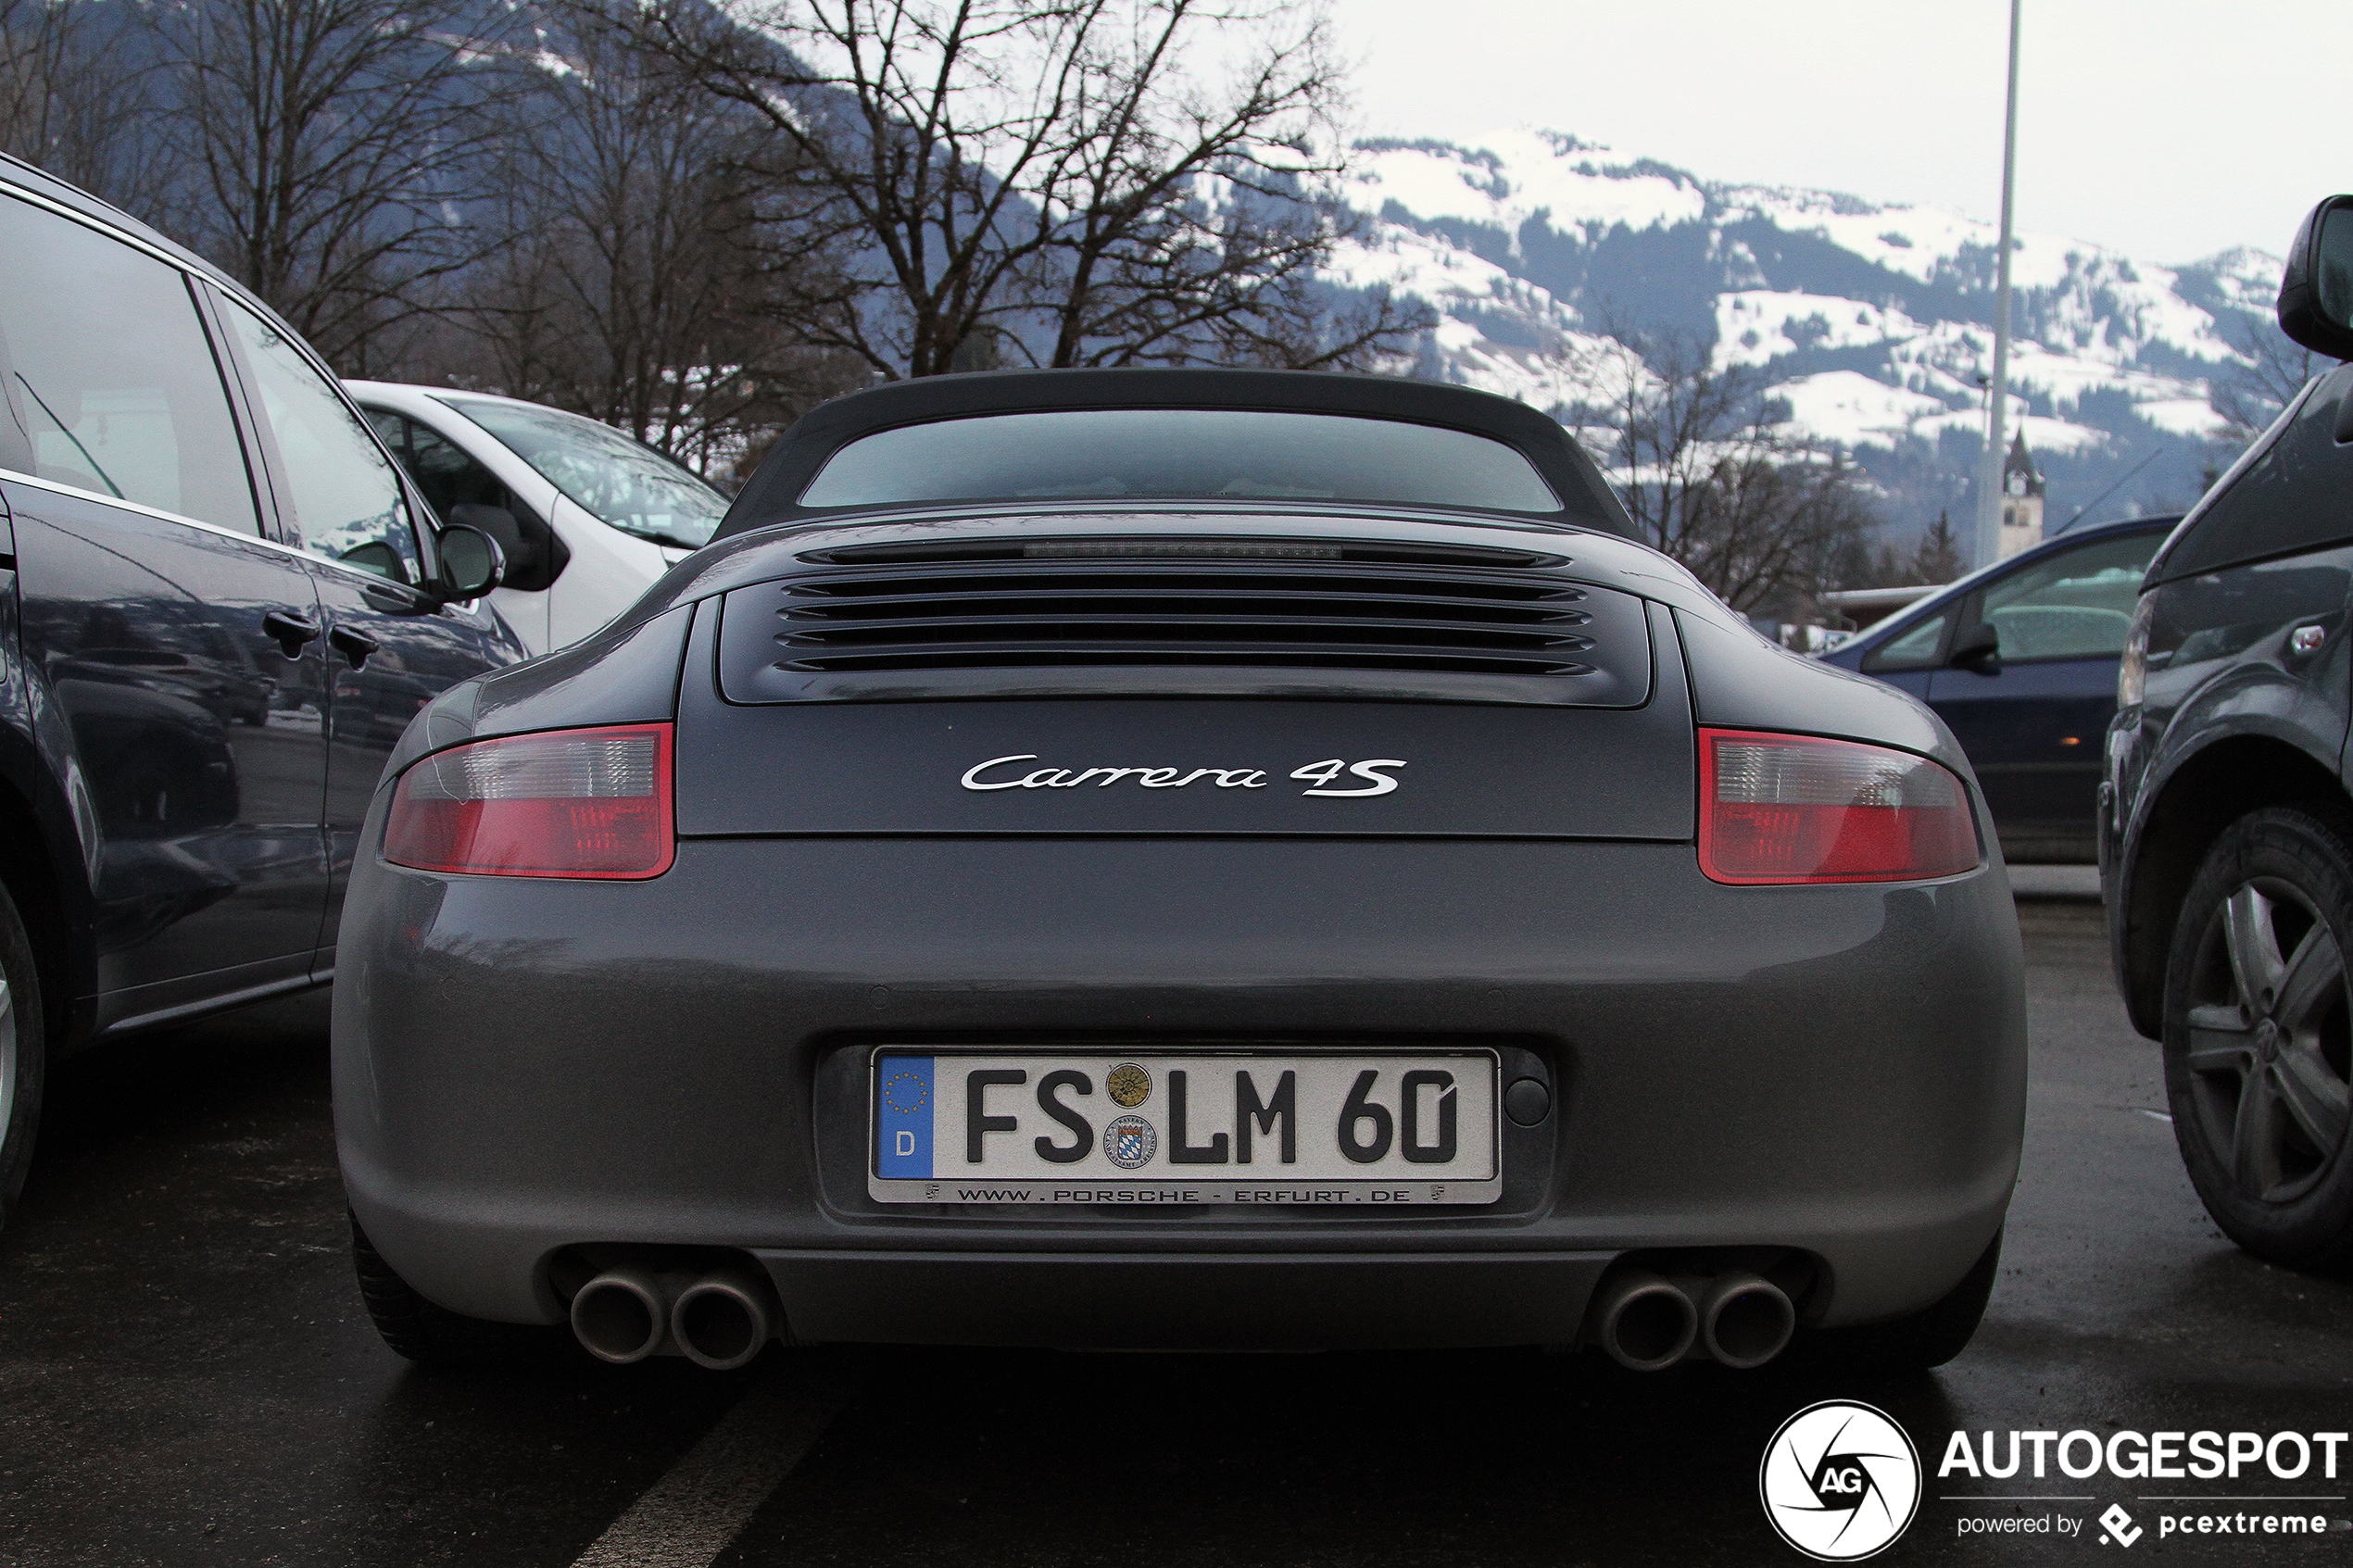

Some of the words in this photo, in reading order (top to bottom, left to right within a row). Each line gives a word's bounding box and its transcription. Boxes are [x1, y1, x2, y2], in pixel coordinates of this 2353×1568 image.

[961, 754, 1267, 790] Carrera
[1290, 759, 1408, 797] 4S
[966, 1069, 1095, 1164] FS
[1168, 1070, 1297, 1165] LM
[1337, 1069, 1458, 1164] 60
[896, 1130, 915, 1157] D
